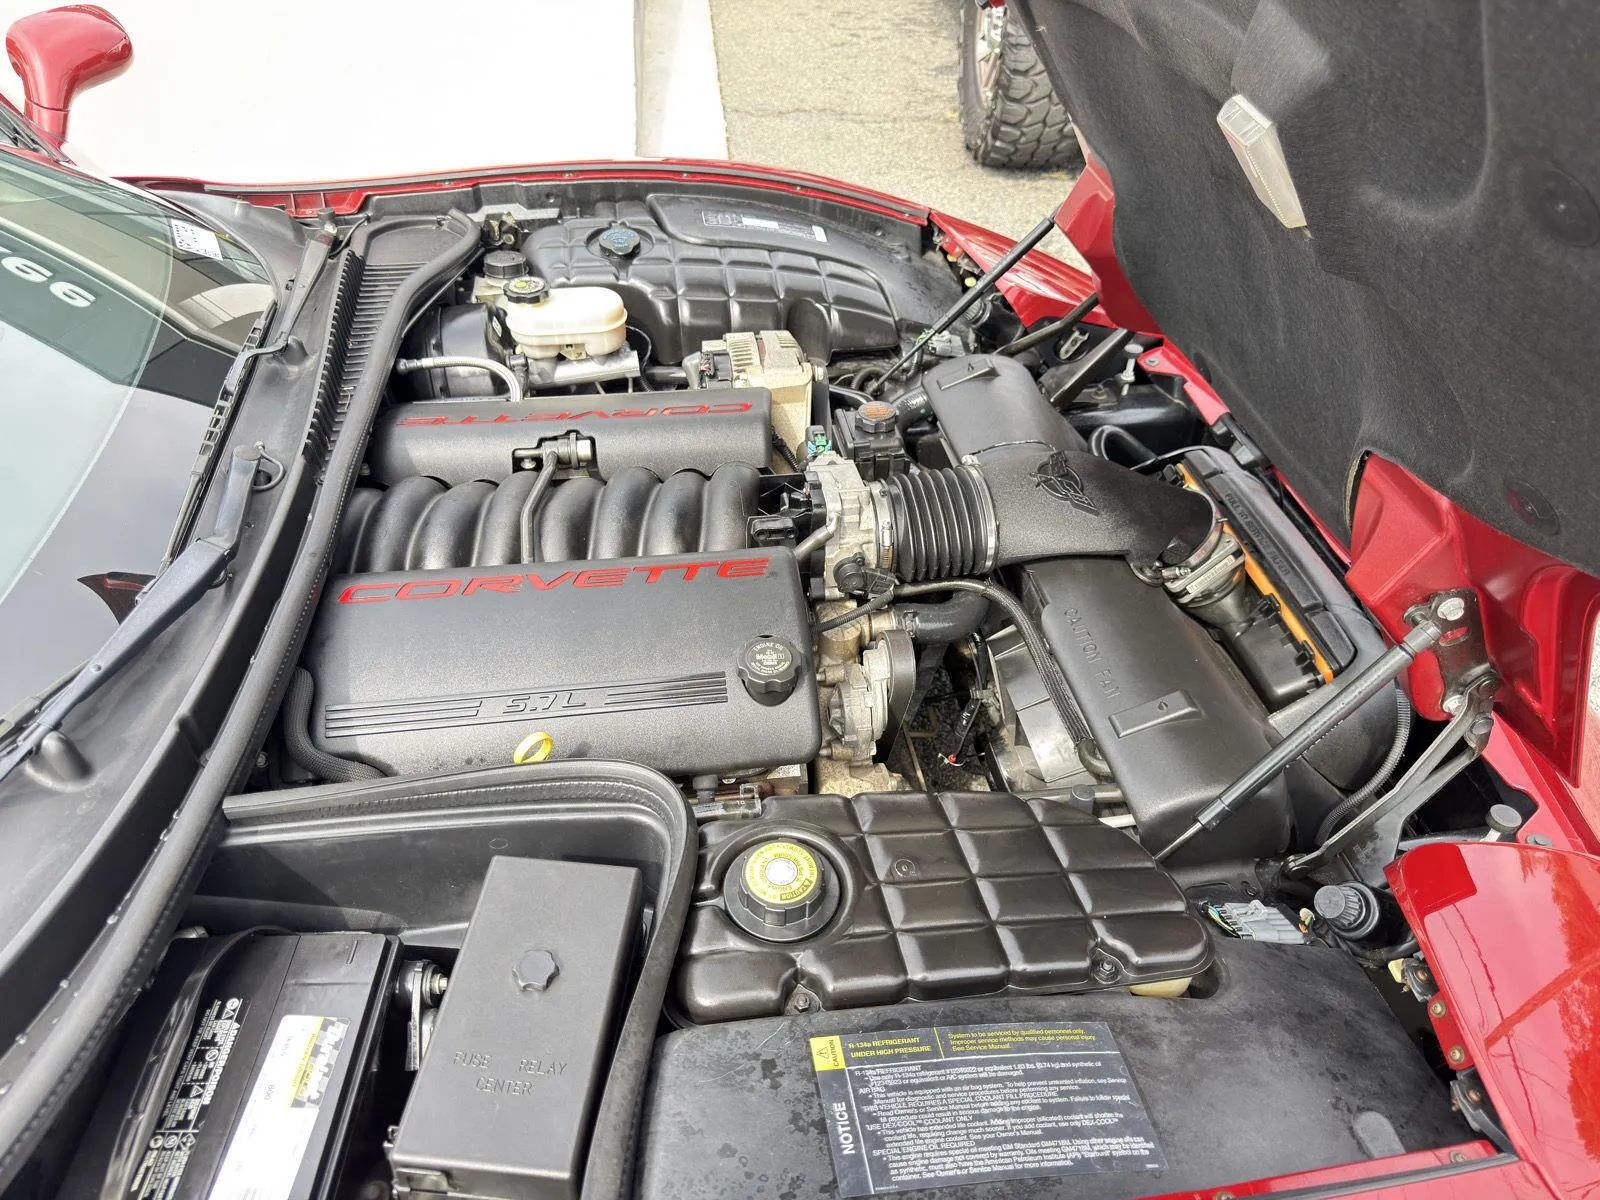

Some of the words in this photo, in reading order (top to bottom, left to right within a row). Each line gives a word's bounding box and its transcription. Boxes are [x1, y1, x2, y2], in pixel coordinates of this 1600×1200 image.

[396, 402, 752, 426] CORVETTE
[337, 557, 772, 603] CORVETTE
[1064, 608, 1102, 663] CAUTION
[501, 690, 587, 714] 5.7L
[830, 1040, 840, 1066] CAUTION
[871, 1037, 920, 1046] REFRIGERANT
[894, 1045, 932, 1054] PRESSURE
[453, 1051, 491, 1068] FUSE
[519, 1060, 567, 1076] RELAY
[476, 1077, 532, 1096] CENTER
[833, 1102, 856, 1155] NOTICE
